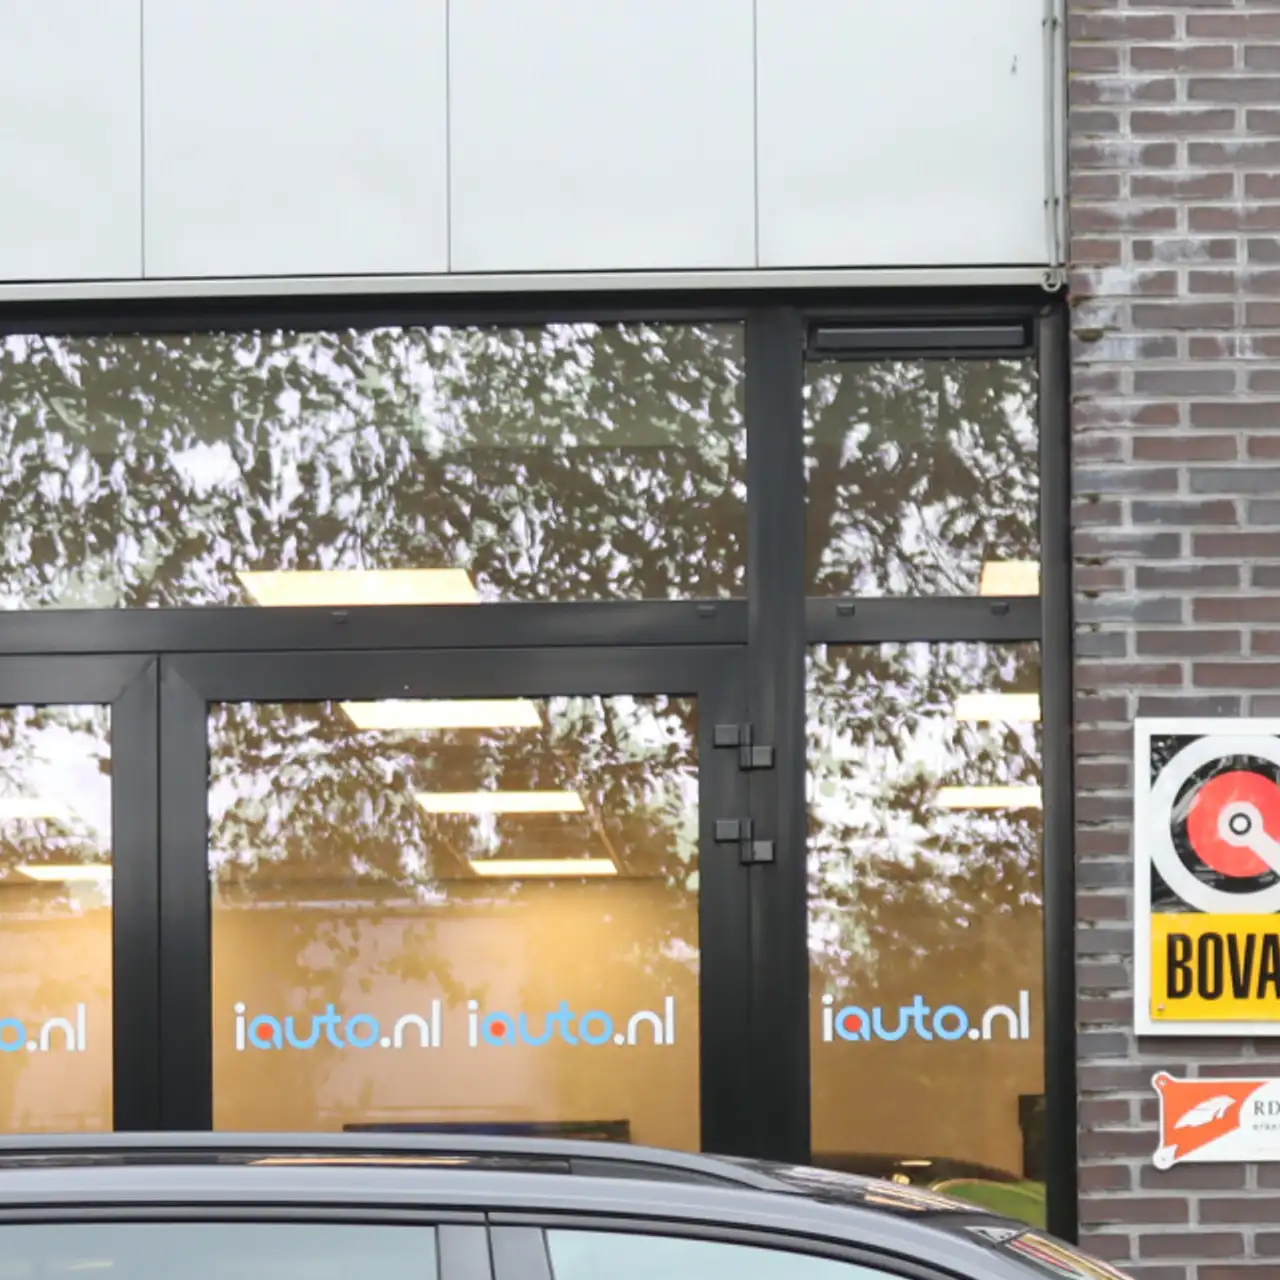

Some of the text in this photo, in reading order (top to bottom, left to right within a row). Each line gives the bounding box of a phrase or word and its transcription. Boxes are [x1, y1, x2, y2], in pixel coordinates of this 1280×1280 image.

[235, 1000, 442, 1051] iauto.nl
[468, 996, 675, 1048] iauto.nl
[822, 989, 1030, 1042] iauto.nl
